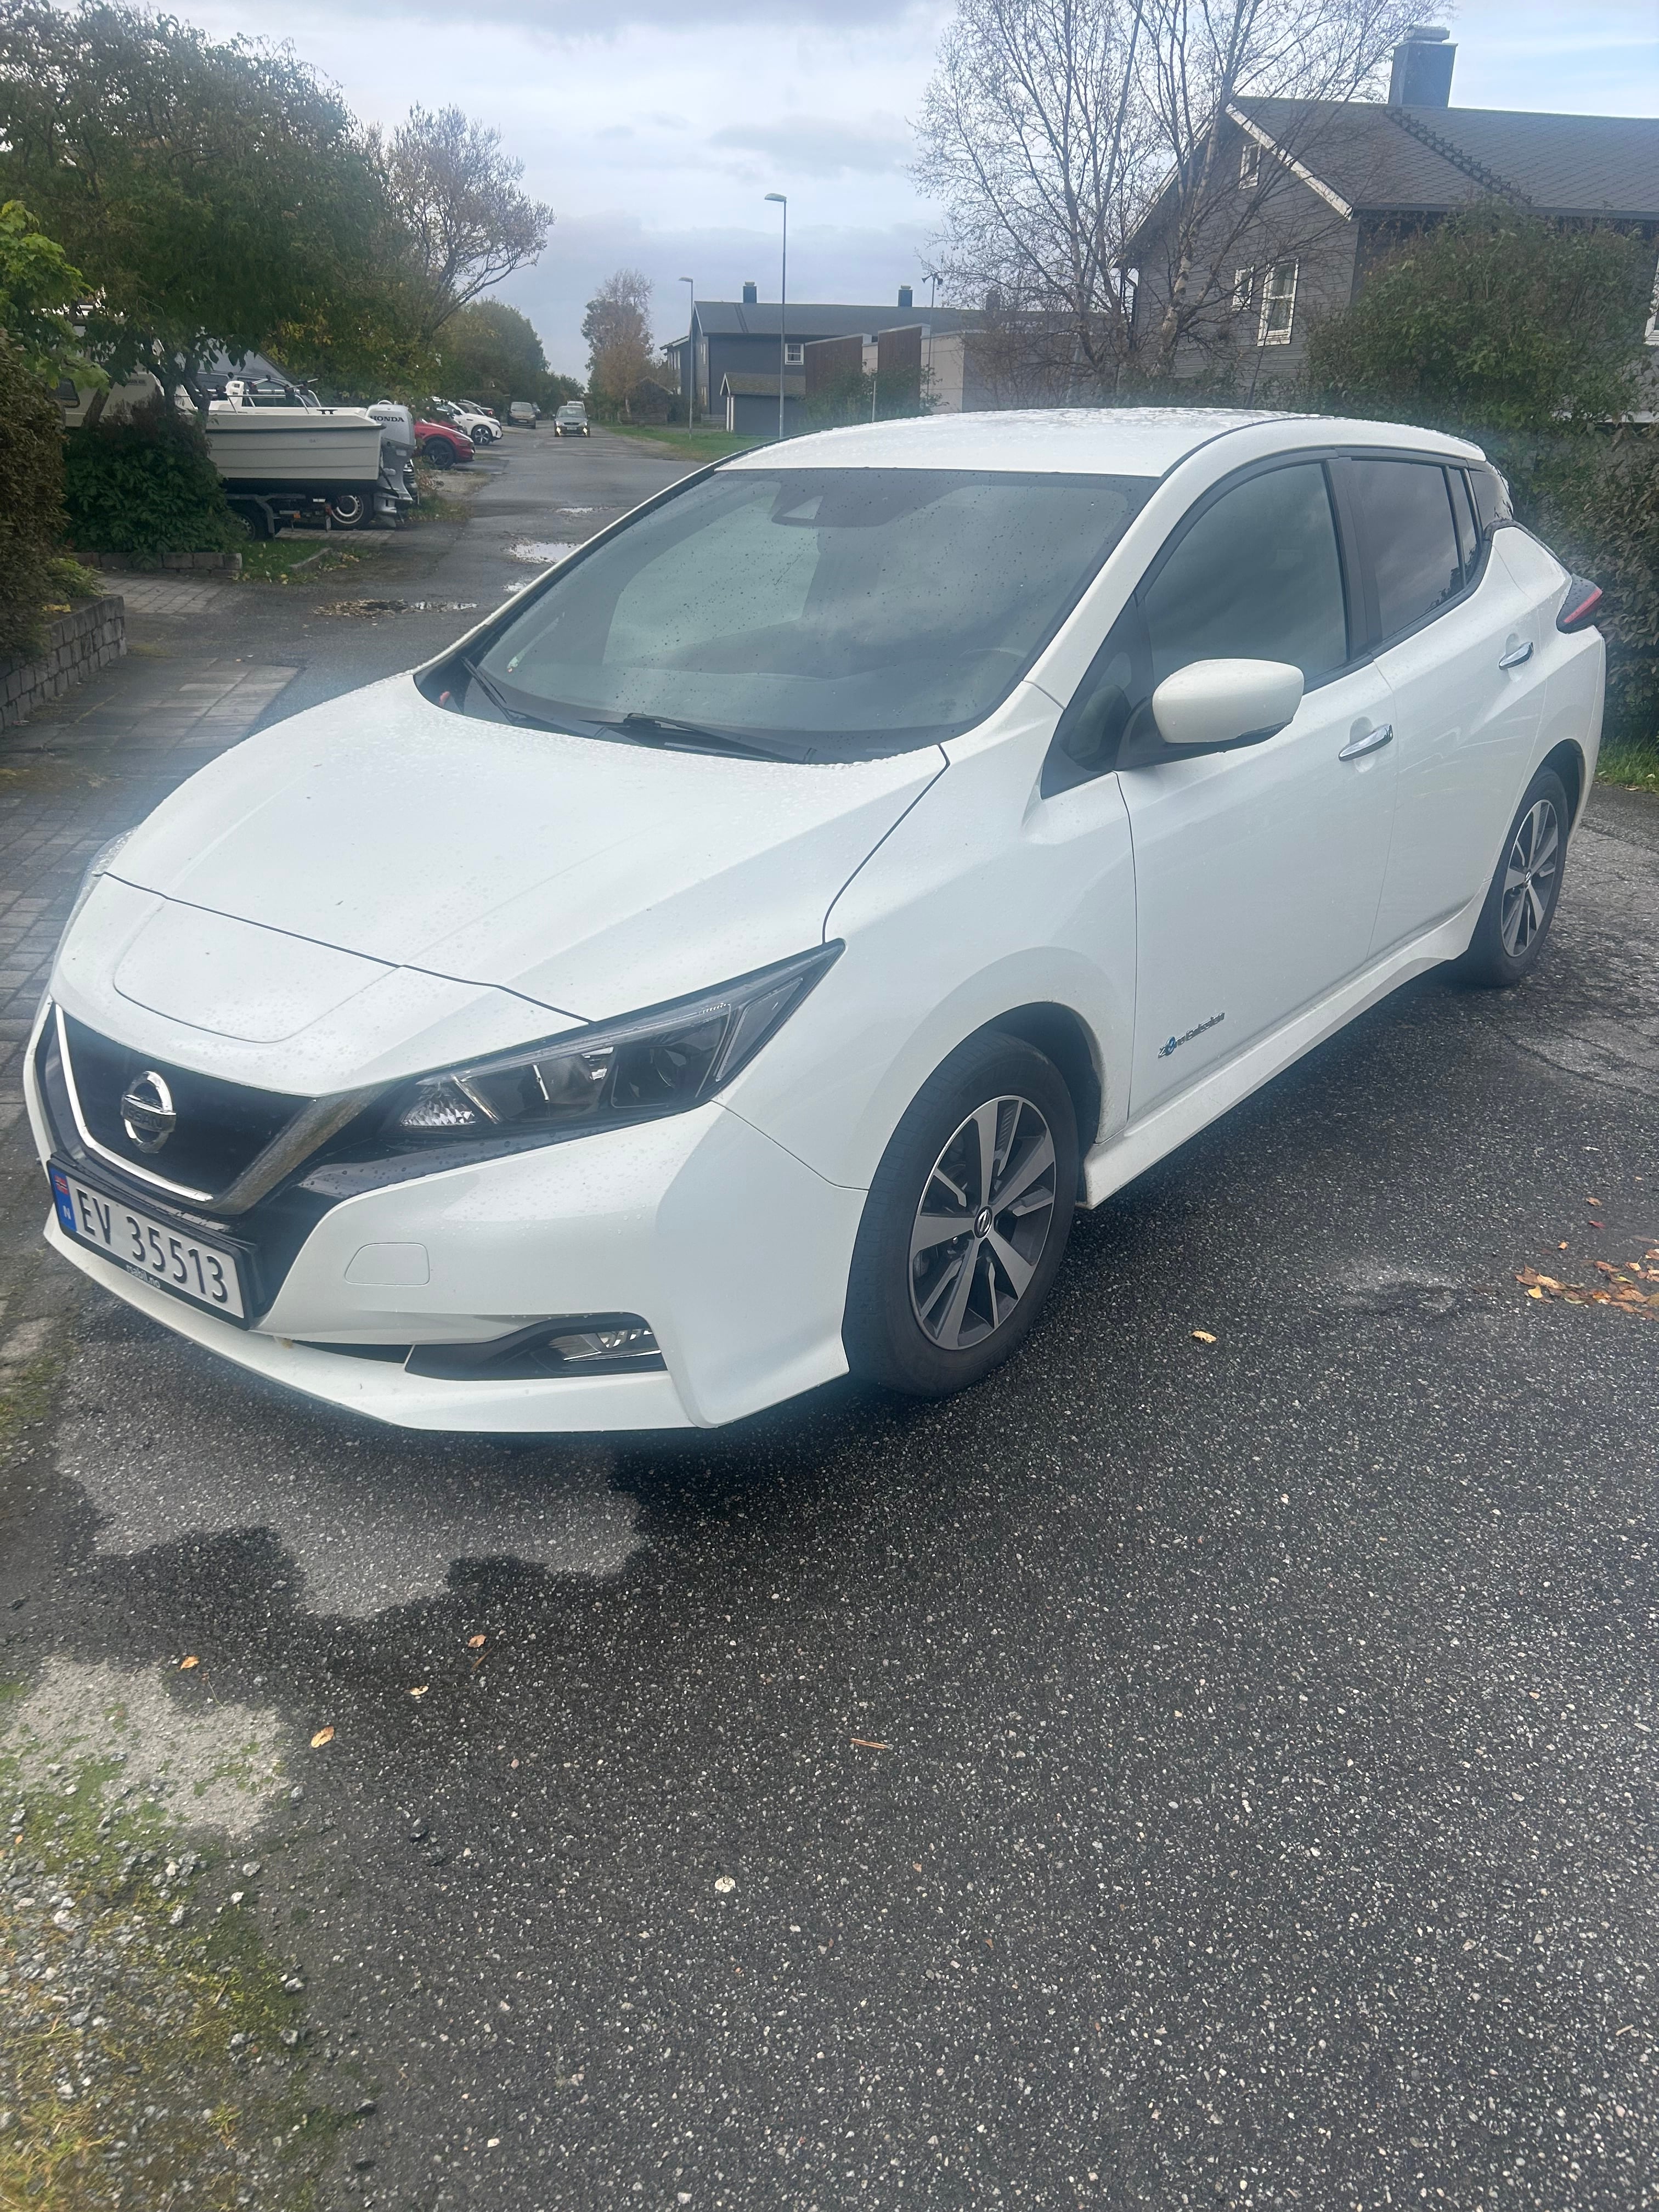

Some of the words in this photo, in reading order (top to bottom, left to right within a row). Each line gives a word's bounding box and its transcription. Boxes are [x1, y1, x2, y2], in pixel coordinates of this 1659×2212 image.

[63, 1205, 72, 1220] N
[76, 1187, 111, 1245] EV
[126, 1216, 228, 1304] 35513
